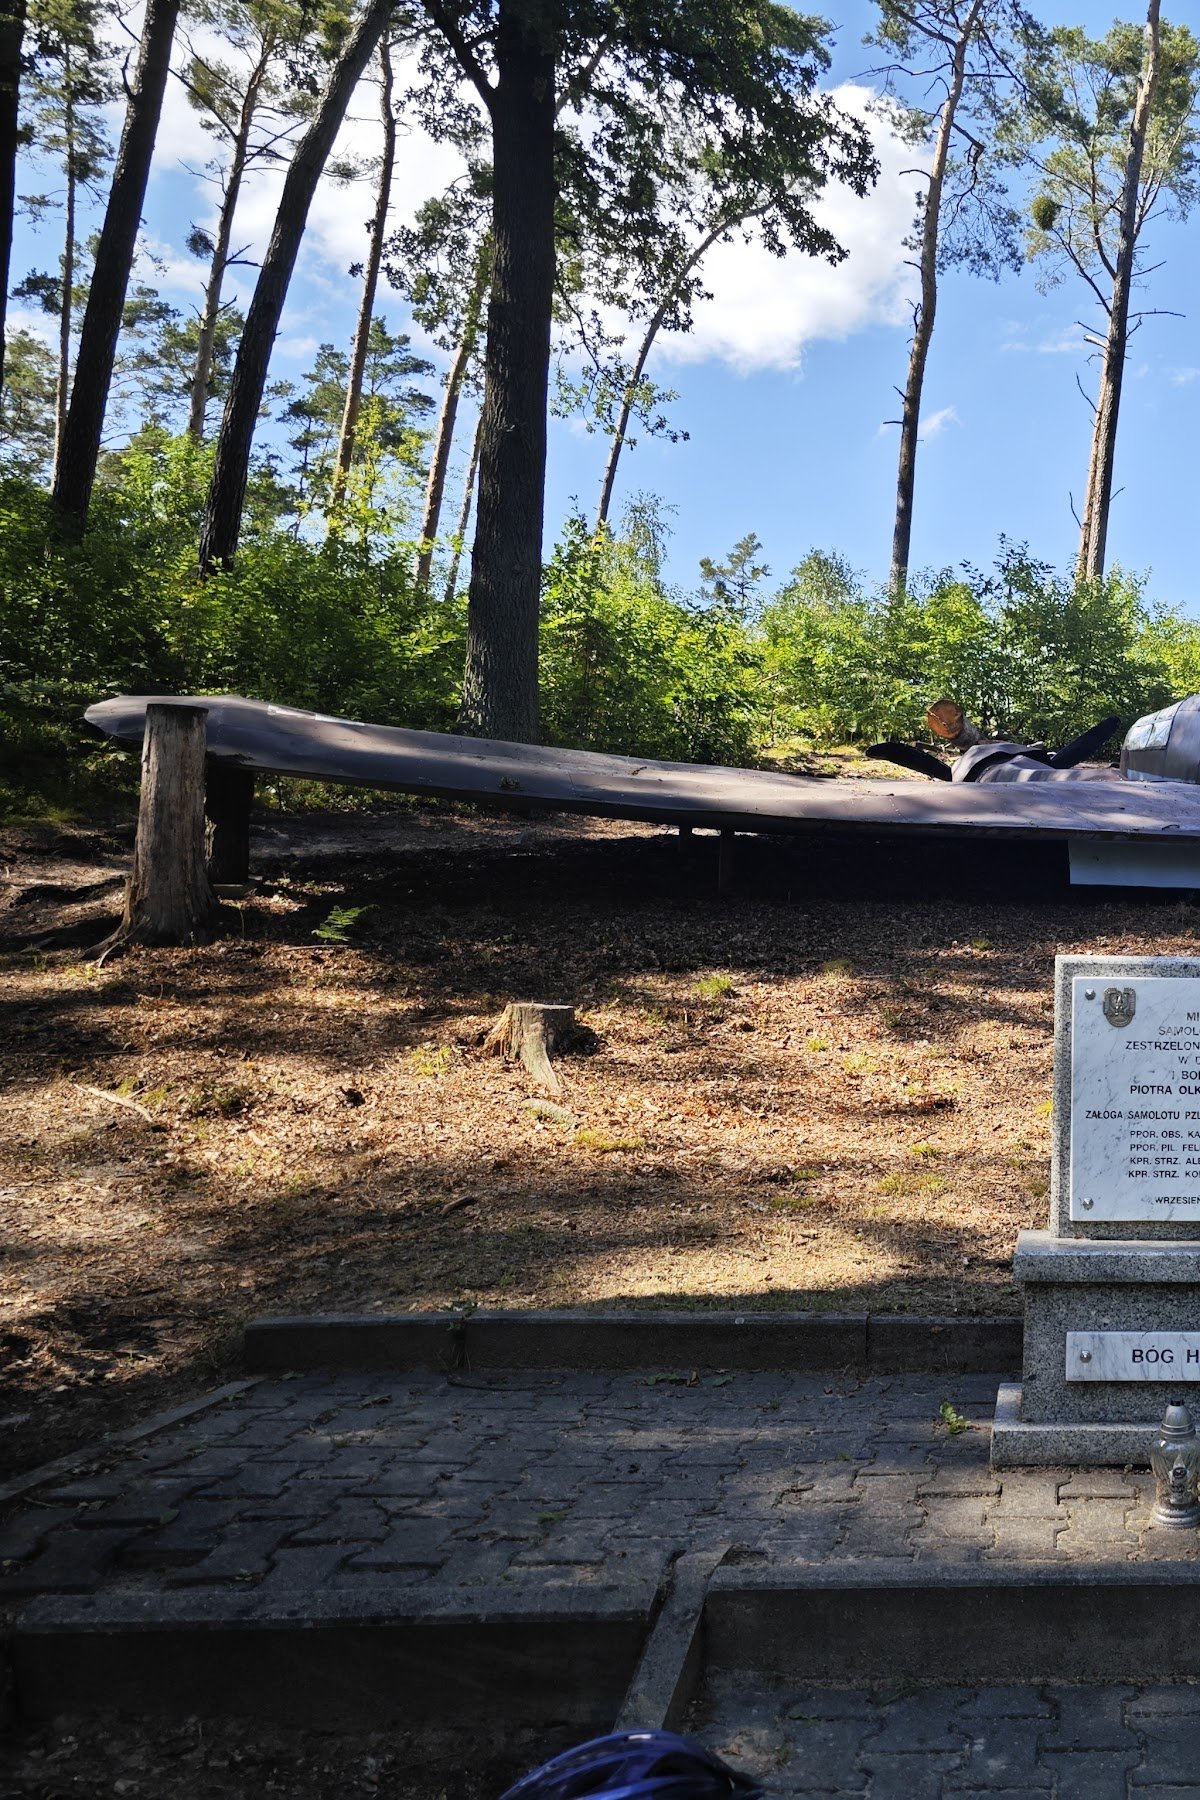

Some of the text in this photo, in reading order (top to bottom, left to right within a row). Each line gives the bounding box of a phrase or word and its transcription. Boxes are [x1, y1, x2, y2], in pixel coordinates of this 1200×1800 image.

[1178, 1056, 1188, 1065] W
[1130, 1085, 1172, 1095] PIOTRA
[1085, 1110, 1123, 1119] ZAŁOGA
[1128, 1111, 1180, 1120] SAMOLOTU
[1130, 1131, 1158, 1139] PPOR.
[1161, 1131, 1183, 1139] OBS.
[1130, 1144, 1158, 1152] PPOR.
[1161, 1144, 1178, 1152] PIL.
[1130, 1157, 1151, 1165] KPR.
[1154, 1157, 1181, 1165] STRZ.
[1132, 1345, 1174, 1364] BÓG
